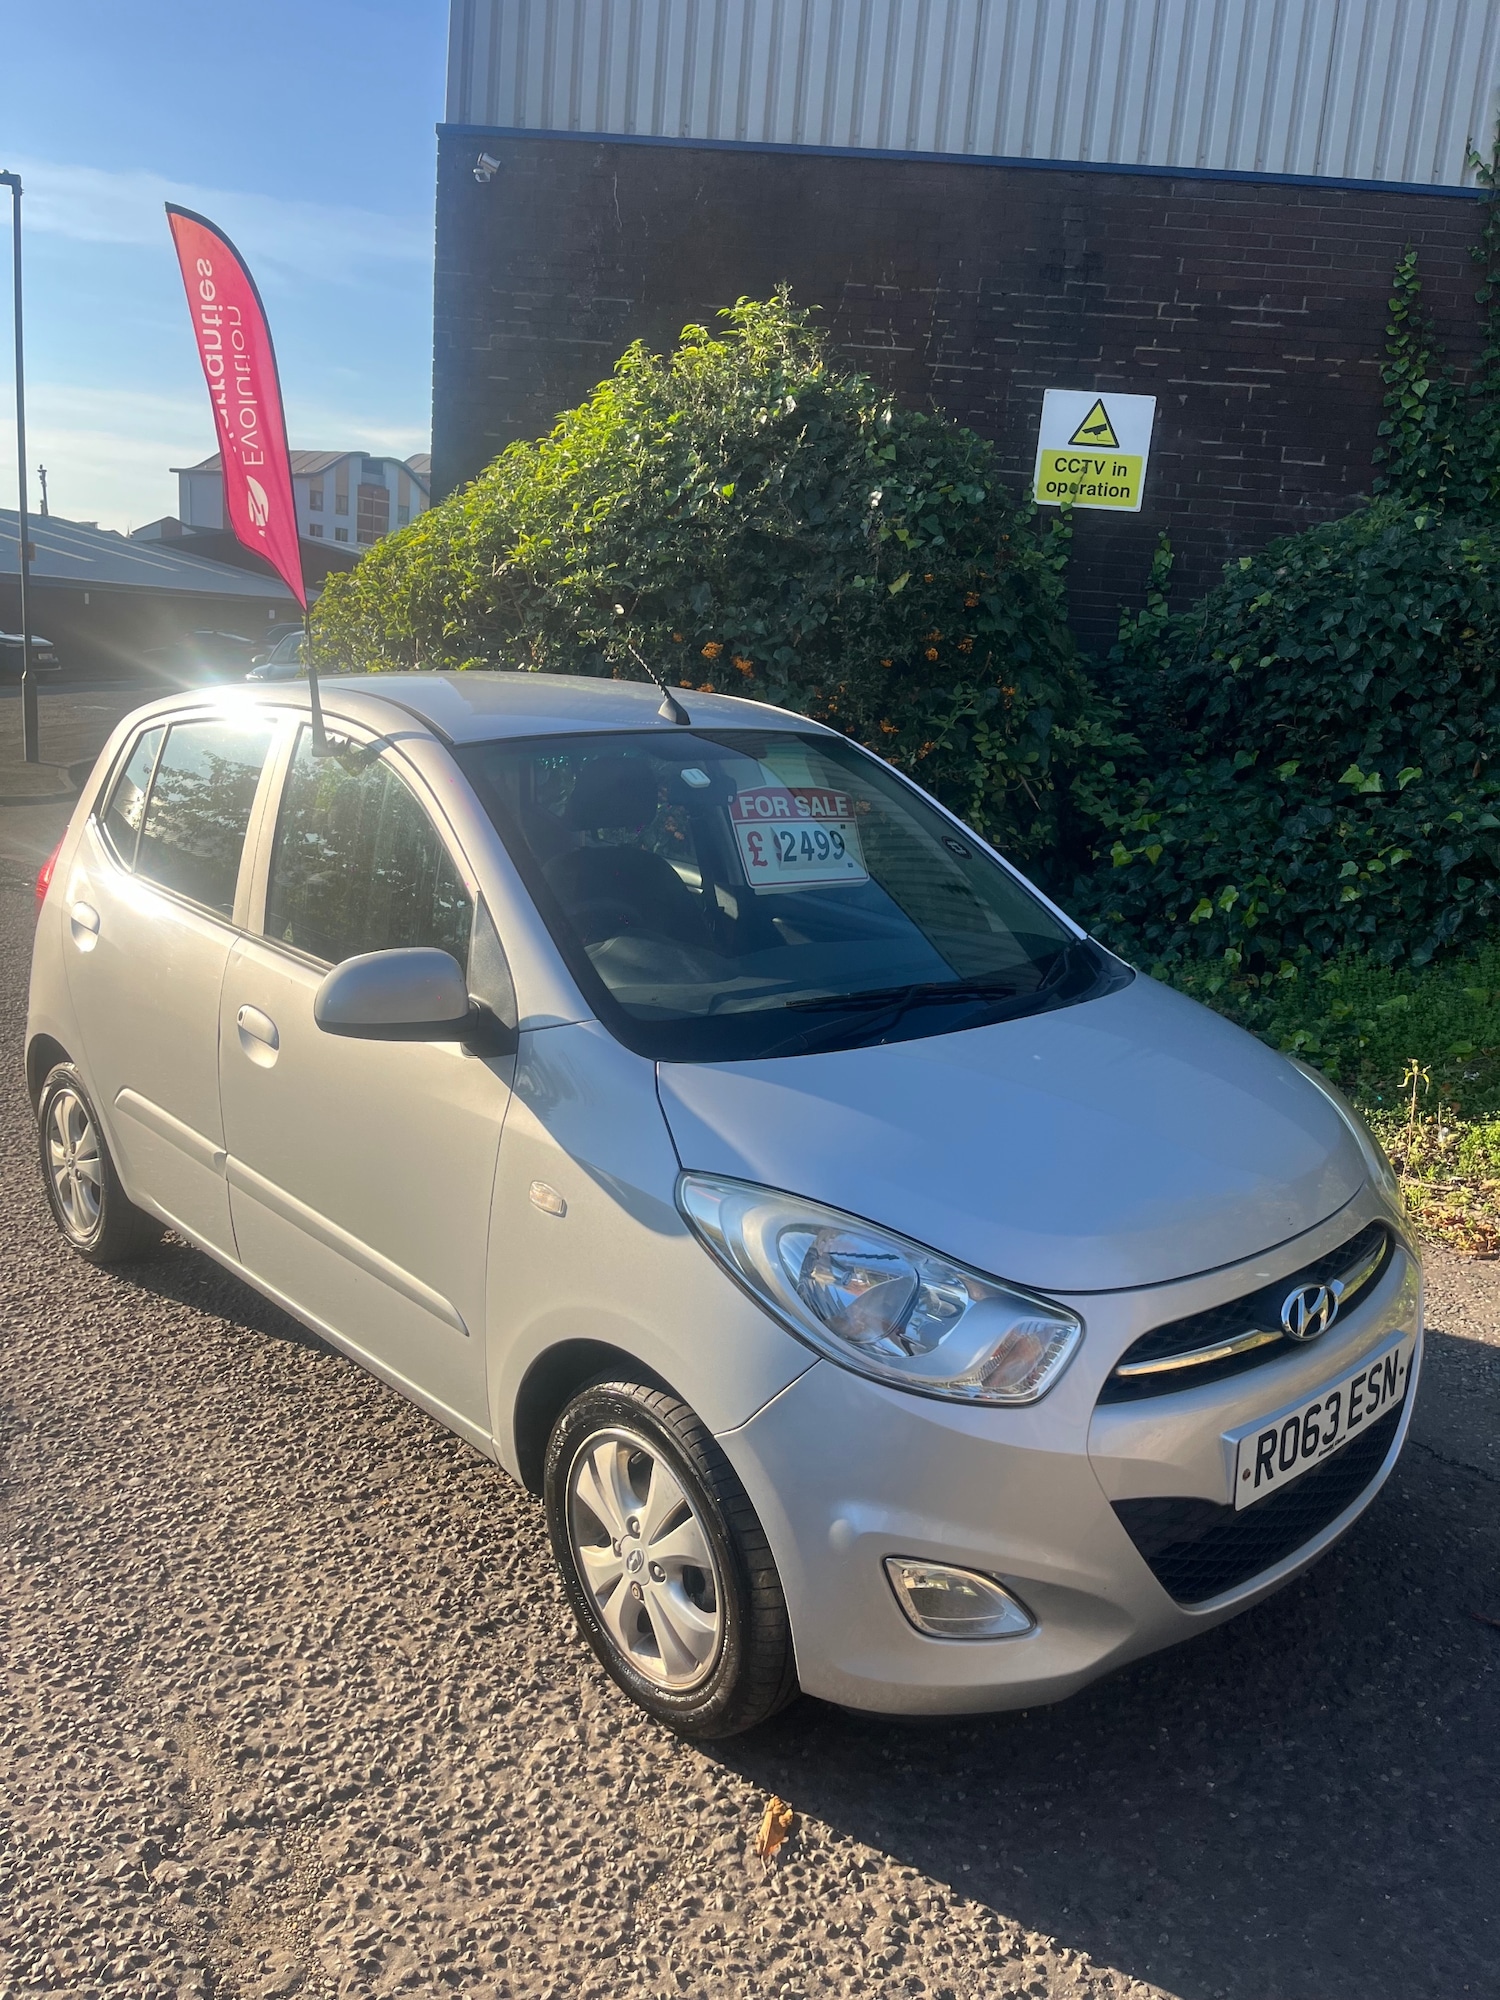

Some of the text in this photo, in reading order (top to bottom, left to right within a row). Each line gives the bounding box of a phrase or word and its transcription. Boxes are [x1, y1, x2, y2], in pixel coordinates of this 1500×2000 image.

[1054, 457, 1128, 477] CCTV in
[739, 795, 849, 818] FOR SALE
[1254, 1349, 1399, 1488] RO63 ESN
